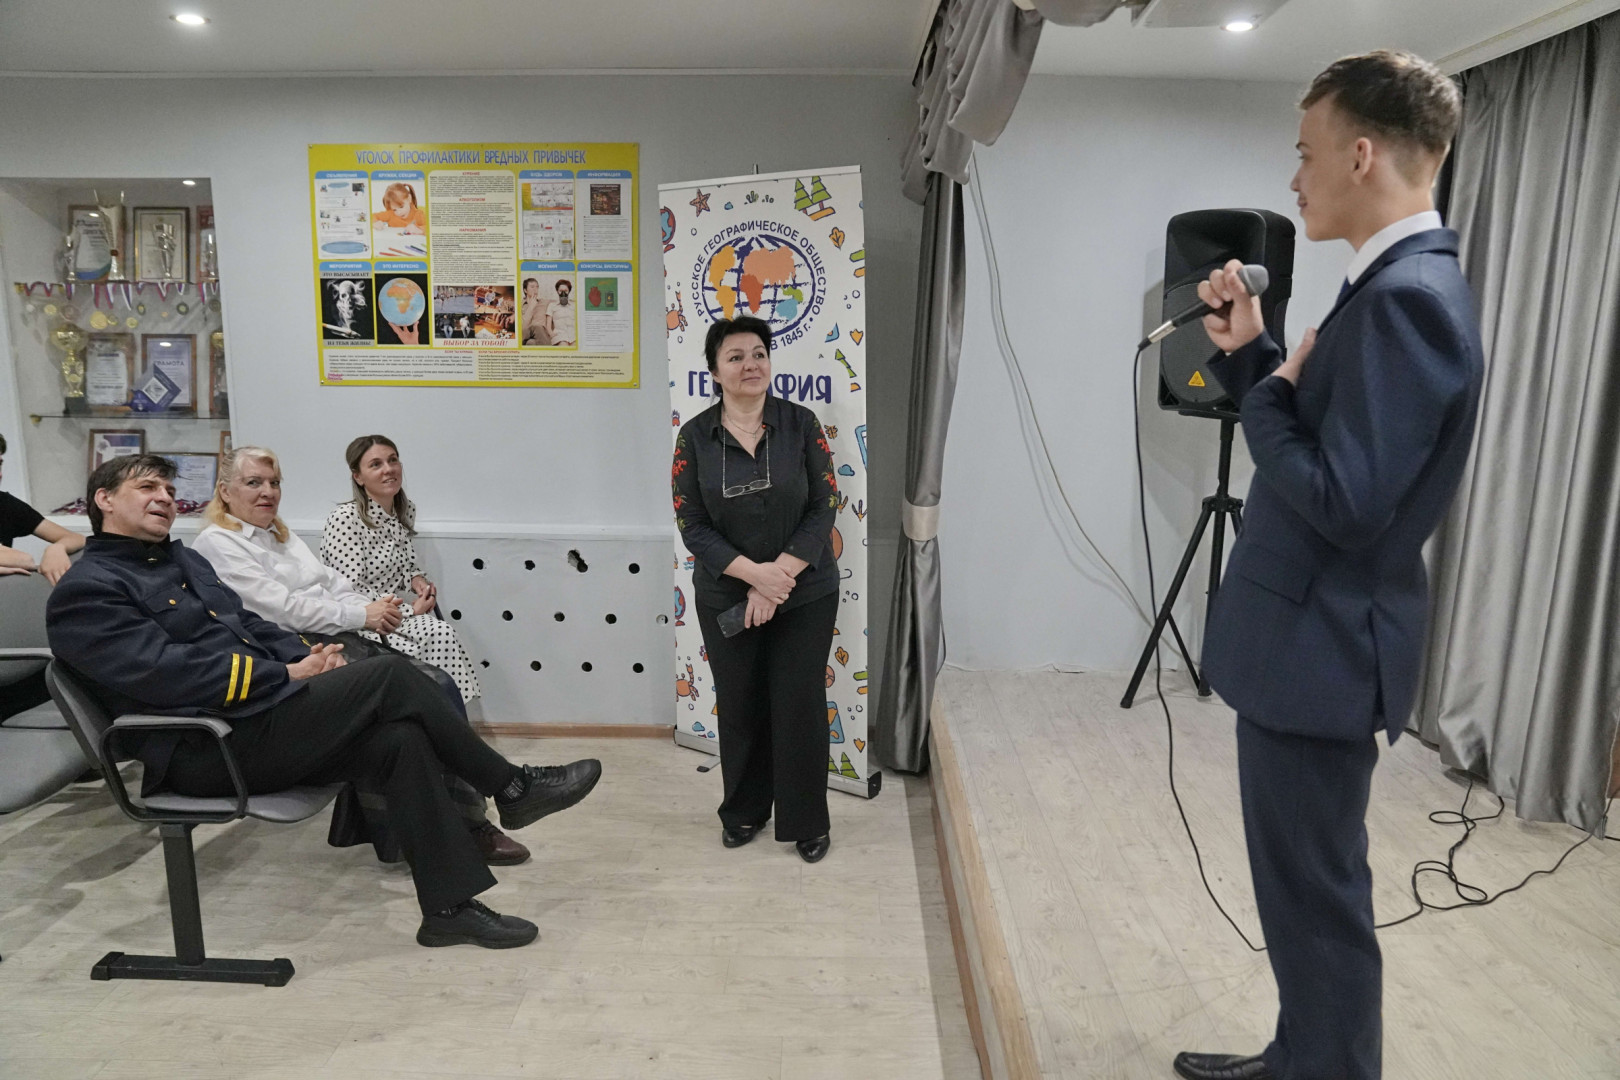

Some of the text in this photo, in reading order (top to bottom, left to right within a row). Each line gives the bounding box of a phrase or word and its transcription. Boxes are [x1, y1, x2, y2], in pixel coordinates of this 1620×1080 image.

[355, 150, 586, 166] УГОЛОК ПРОФИЛАКТИКИ ВРЕДНЫХ ПРИВЫЧЕК
[691, 254, 706, 317] РУССКОЕ
[703, 220, 800, 255] ГЕОГРАФИЧЕСКОЕ
[800, 237, 826, 316] ОБЩЕСТВО
[481, 338, 508, 346] ТОБОЙ!
[770, 339, 778, 351] В
[780, 328, 804, 347] 1845
[688, 371, 832, 404] ГЕФИЯ
